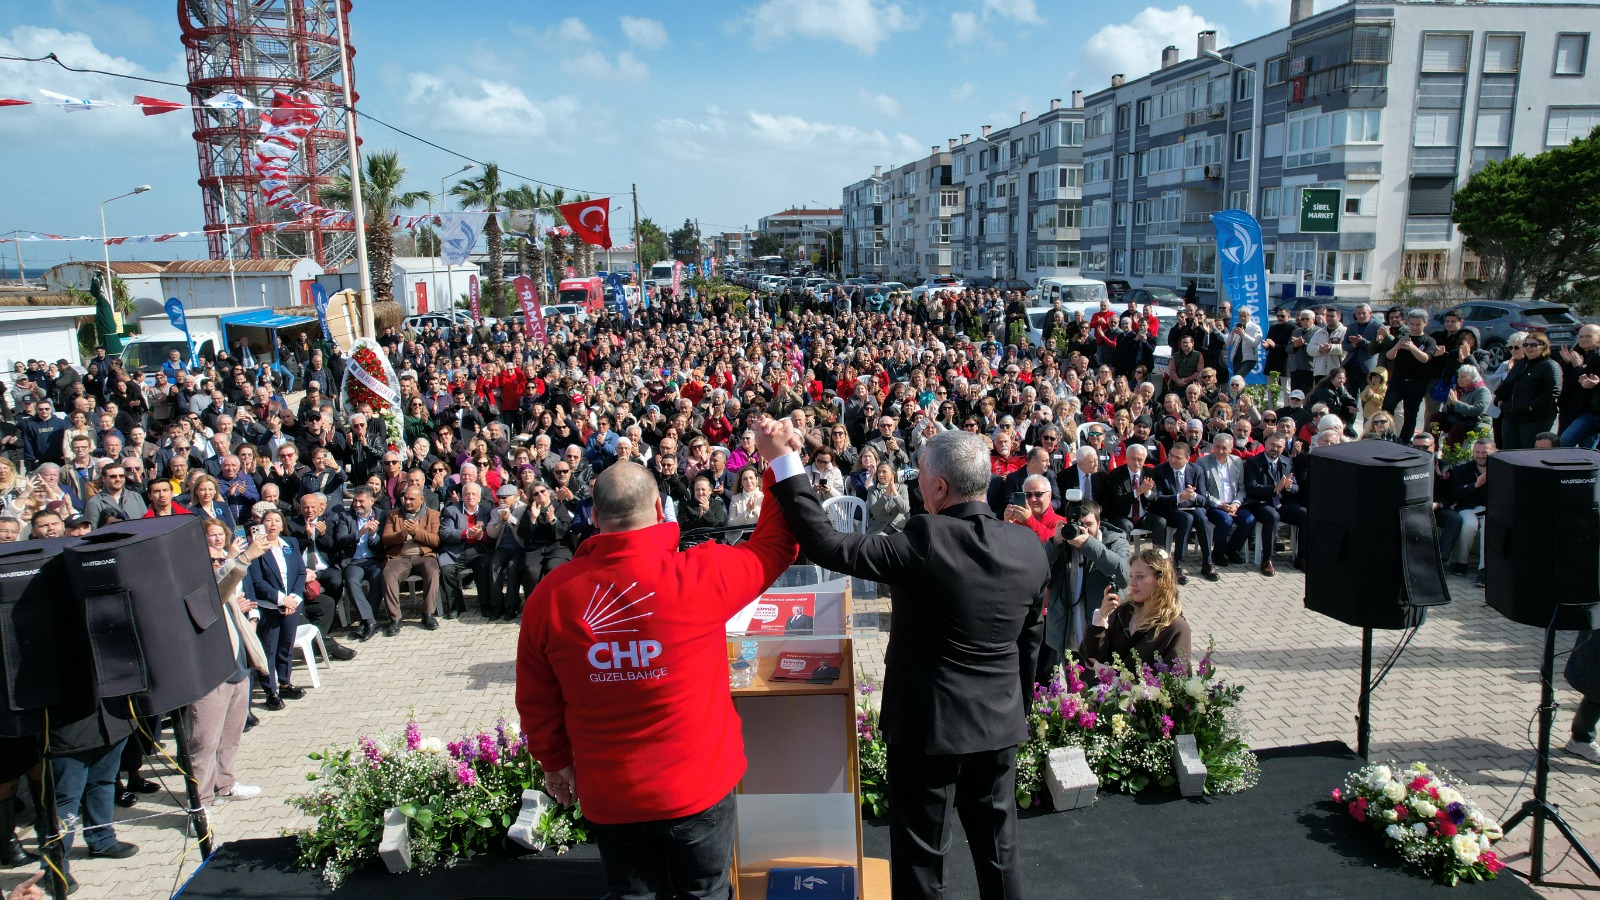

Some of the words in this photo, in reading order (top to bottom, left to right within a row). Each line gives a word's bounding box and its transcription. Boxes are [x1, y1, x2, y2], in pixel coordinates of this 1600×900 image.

[1312, 203, 1330, 211] SİBEL
[588, 640, 662, 669] CHP
[589, 667, 669, 682] GÜZELBAHÇE
